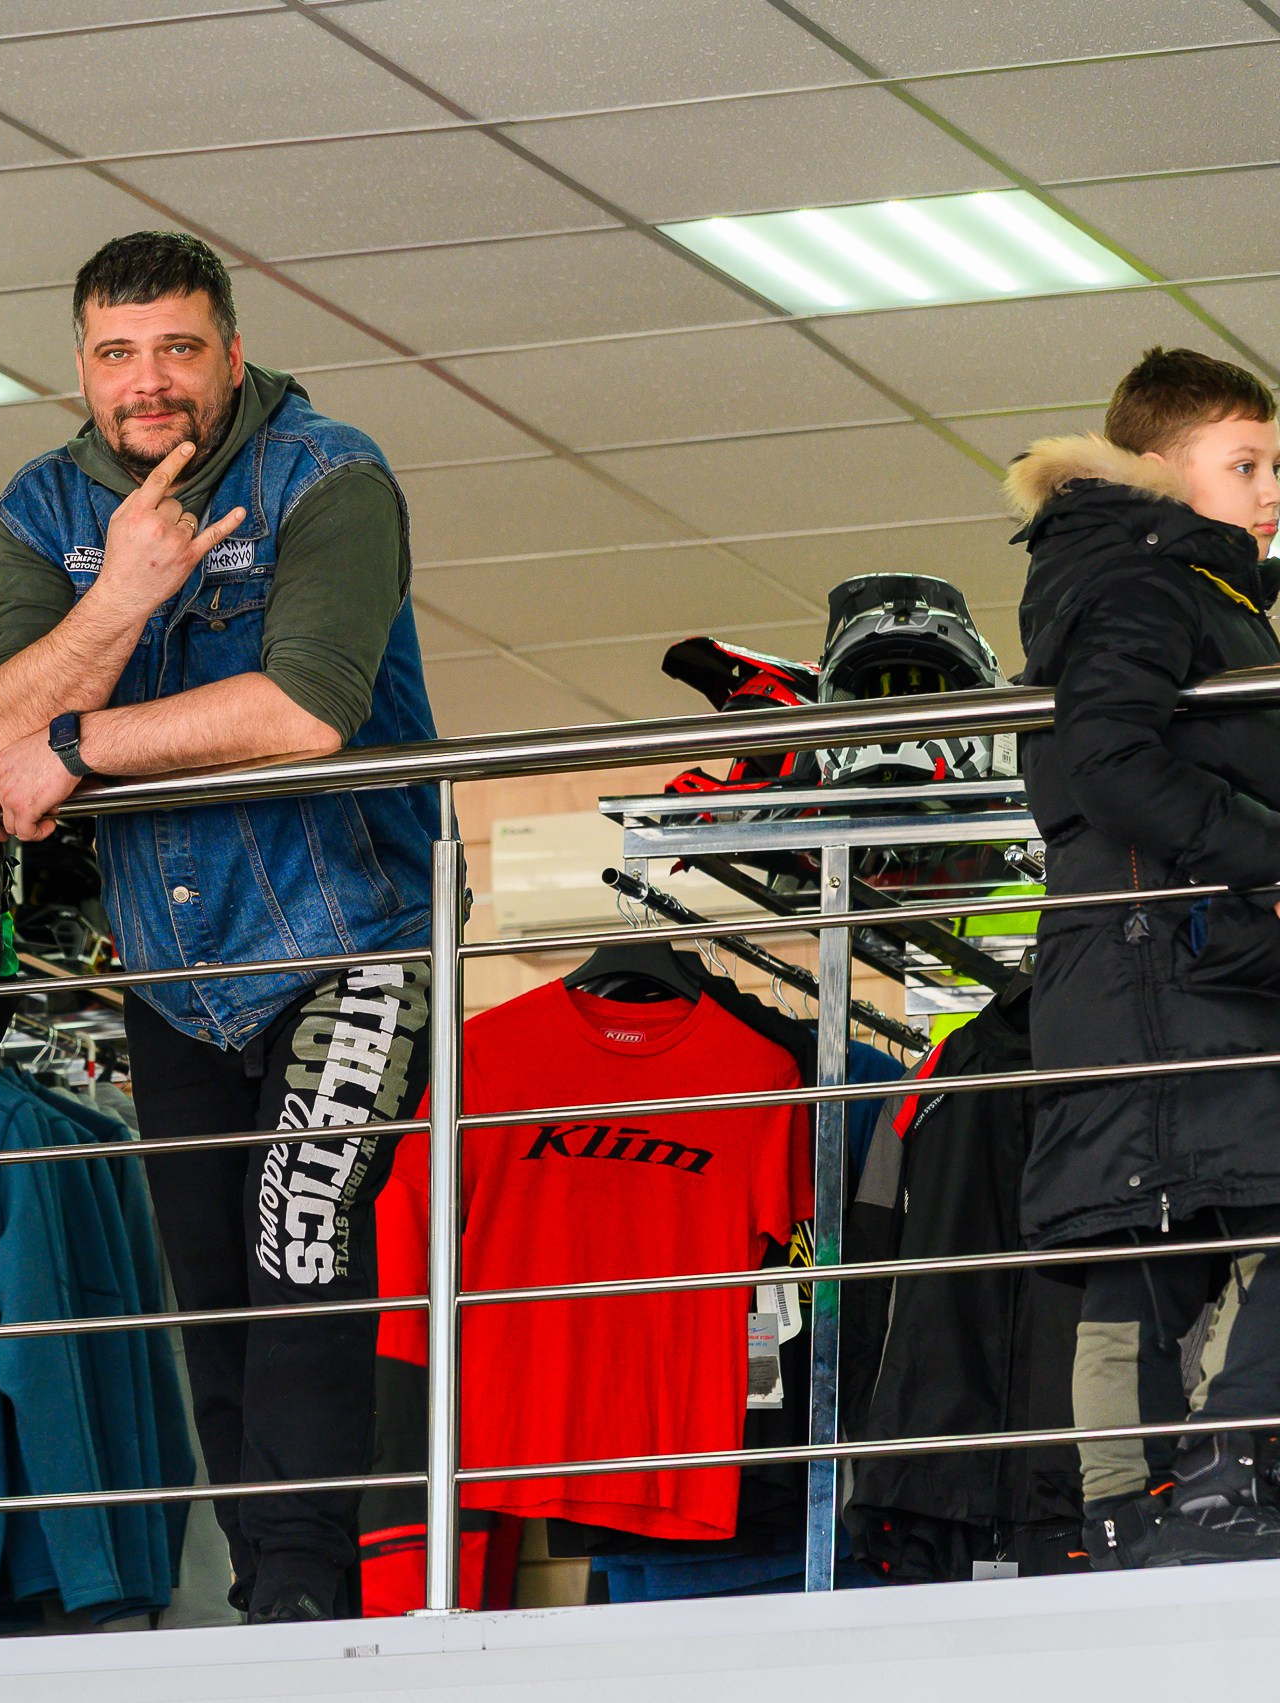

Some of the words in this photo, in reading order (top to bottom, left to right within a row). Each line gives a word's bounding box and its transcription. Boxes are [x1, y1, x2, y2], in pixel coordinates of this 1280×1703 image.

[70, 562, 102, 571] МОТОКЛ
[606, 1032, 640, 1041] Klim
[520, 1125, 714, 1176] Klim
[335, 1216, 350, 1277] STYLE
